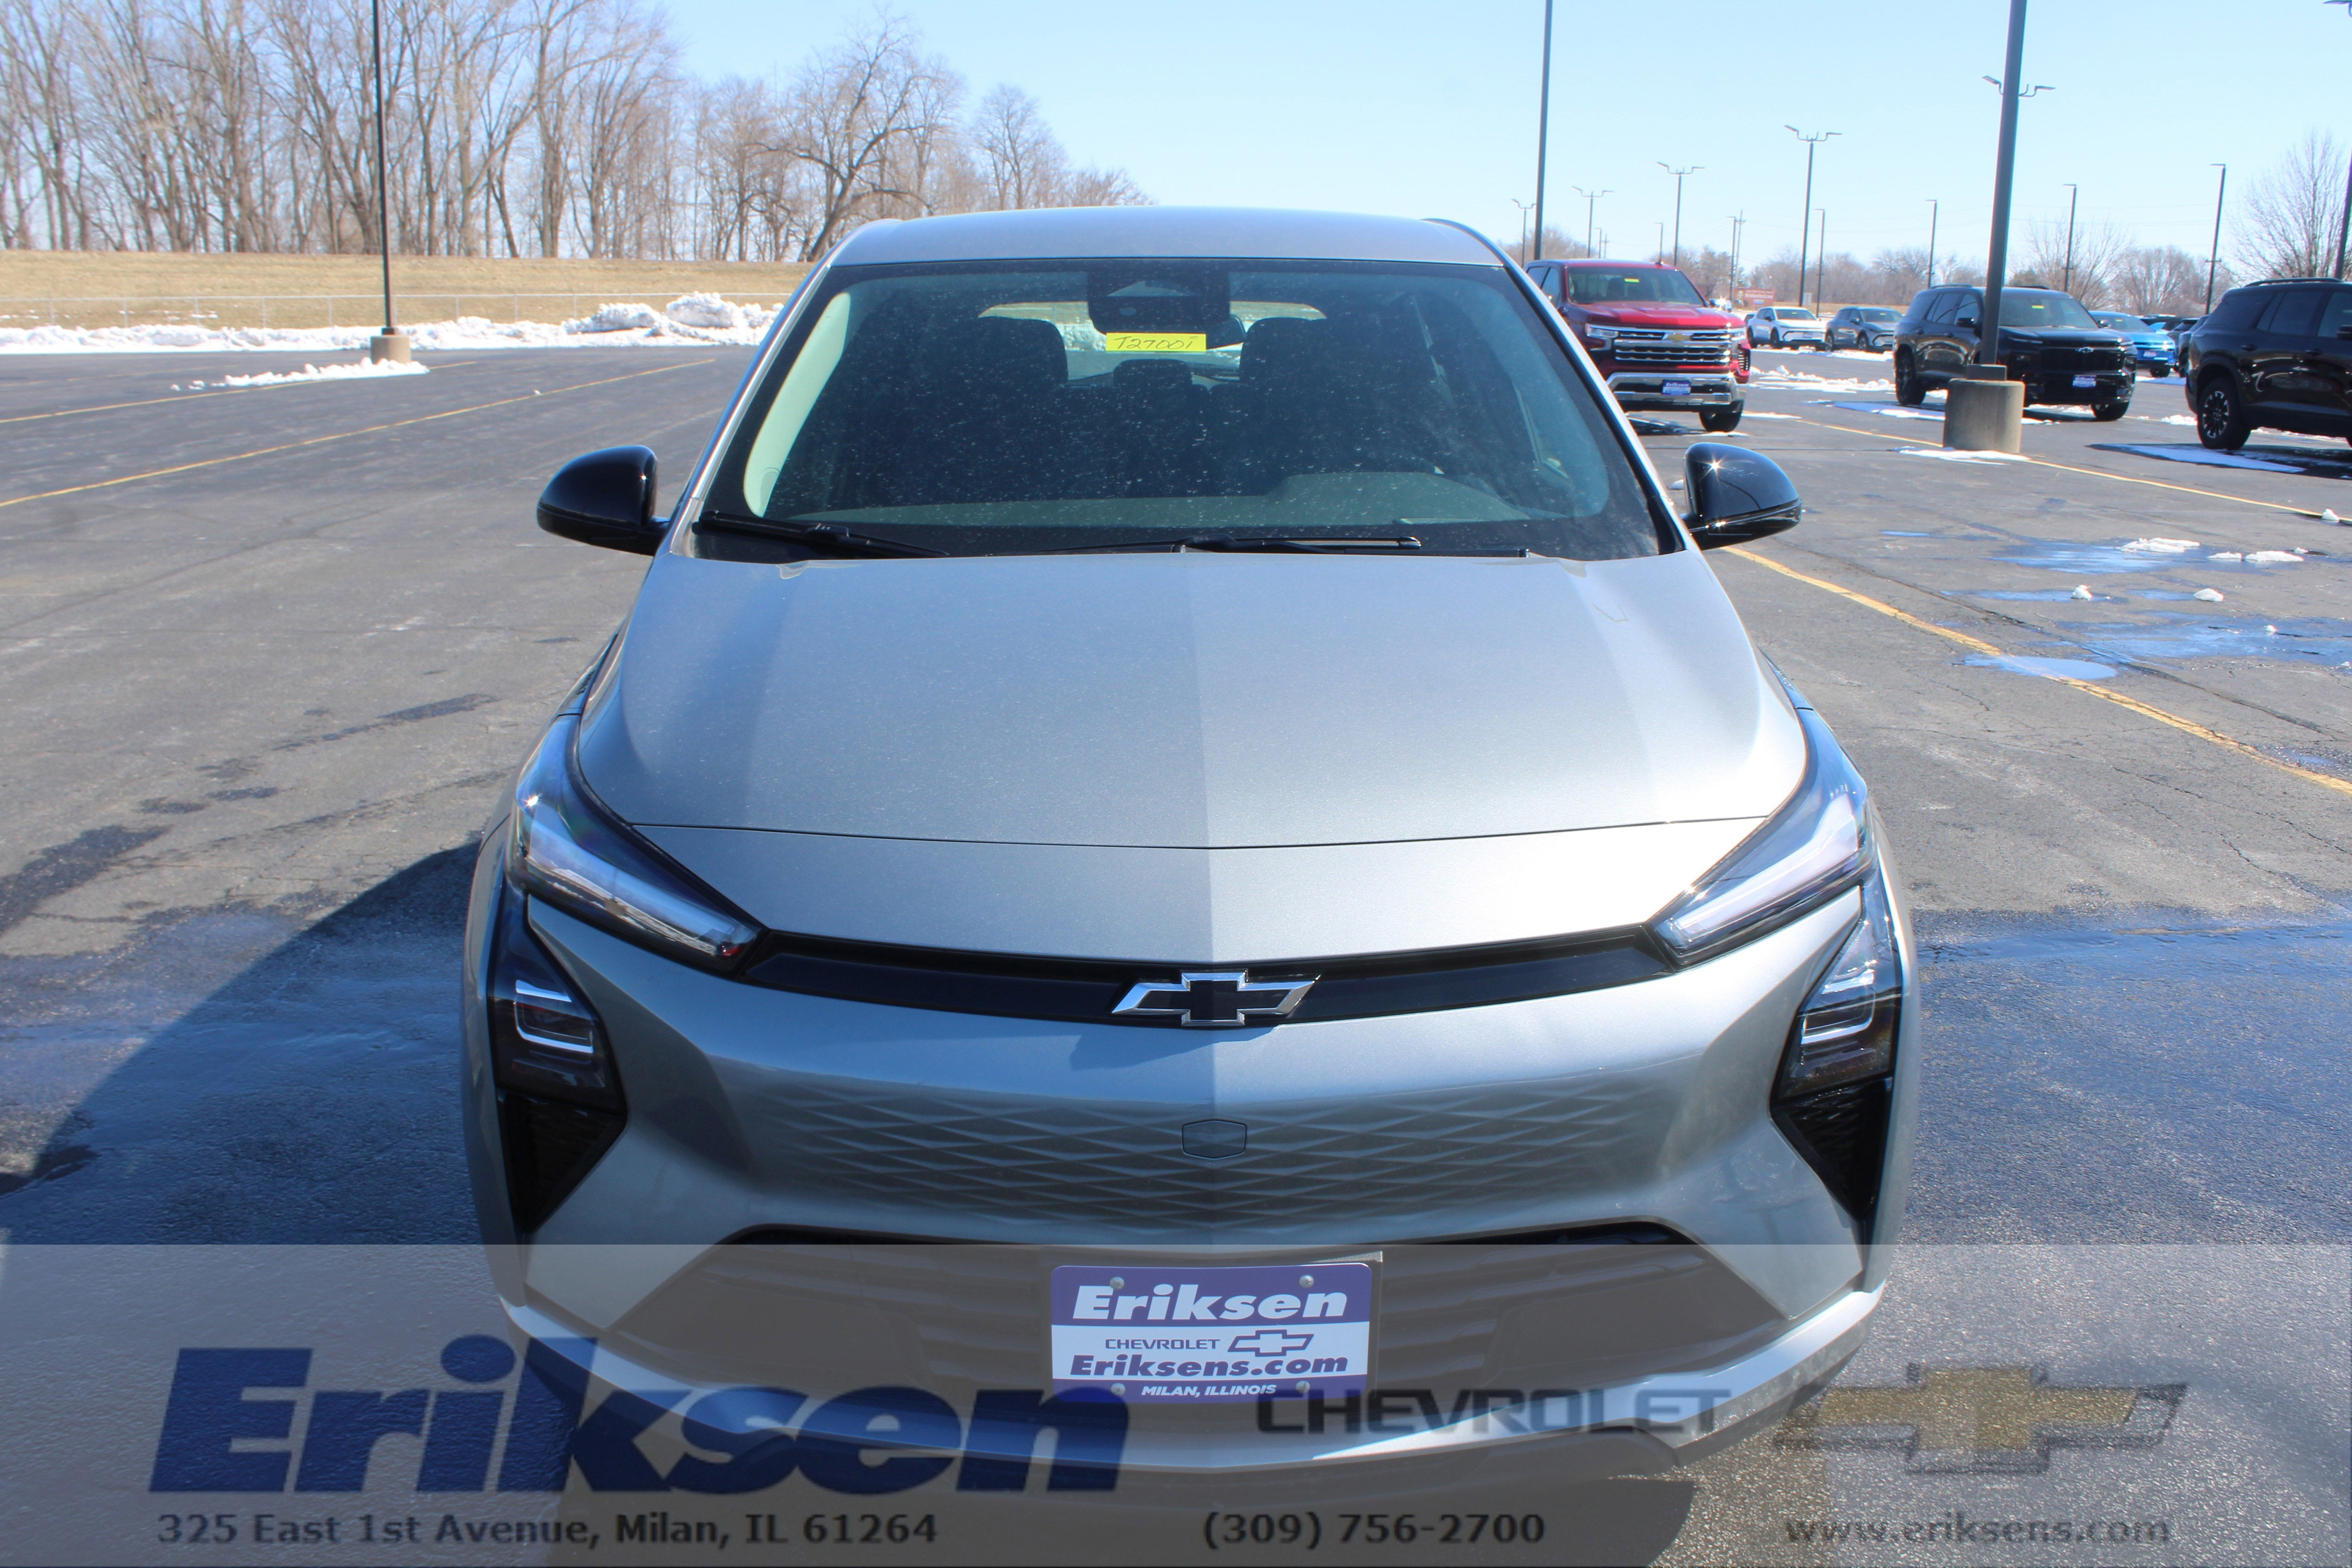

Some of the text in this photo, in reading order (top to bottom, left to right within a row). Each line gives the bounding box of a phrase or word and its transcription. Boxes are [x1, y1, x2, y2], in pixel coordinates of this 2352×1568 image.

[1073, 1283, 1348, 1320] Eriksen
[1105, 1339, 1220, 1349] CHEVROLET
[1070, 1354, 1348, 1376] Eriksens.com
[1141, 1384, 1276, 1397] MILAN, ILLINOIS
